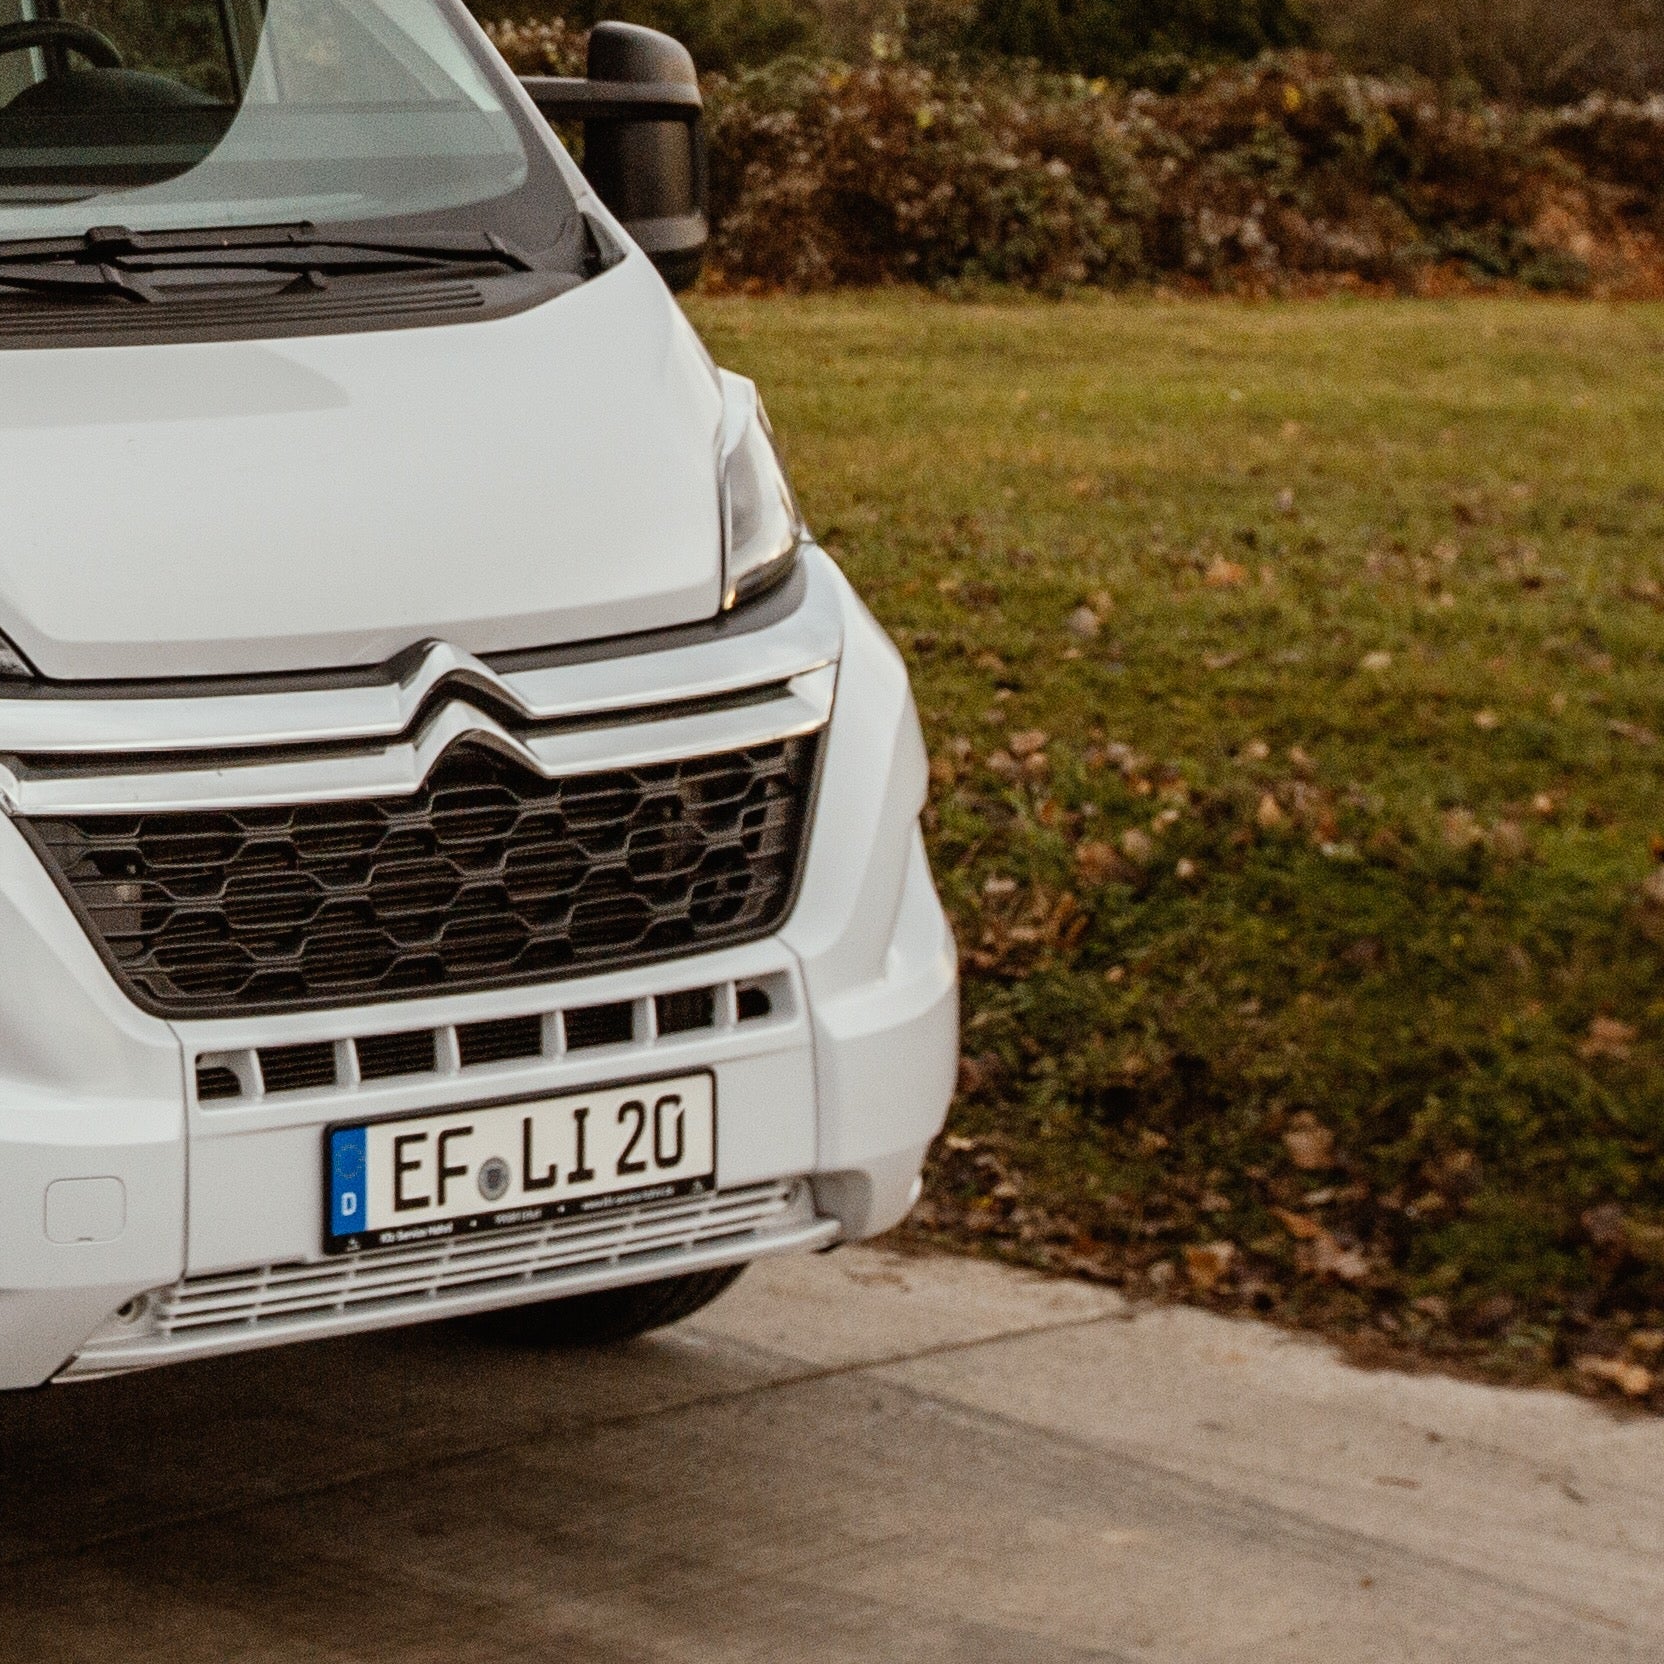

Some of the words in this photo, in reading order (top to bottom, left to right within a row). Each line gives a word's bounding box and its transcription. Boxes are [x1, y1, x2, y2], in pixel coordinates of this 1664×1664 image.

[393, 1125, 474, 1212] EF
[522, 1107, 596, 1192] LI
[616, 1094, 686, 1176] 20
[341, 1191, 357, 1216] D
